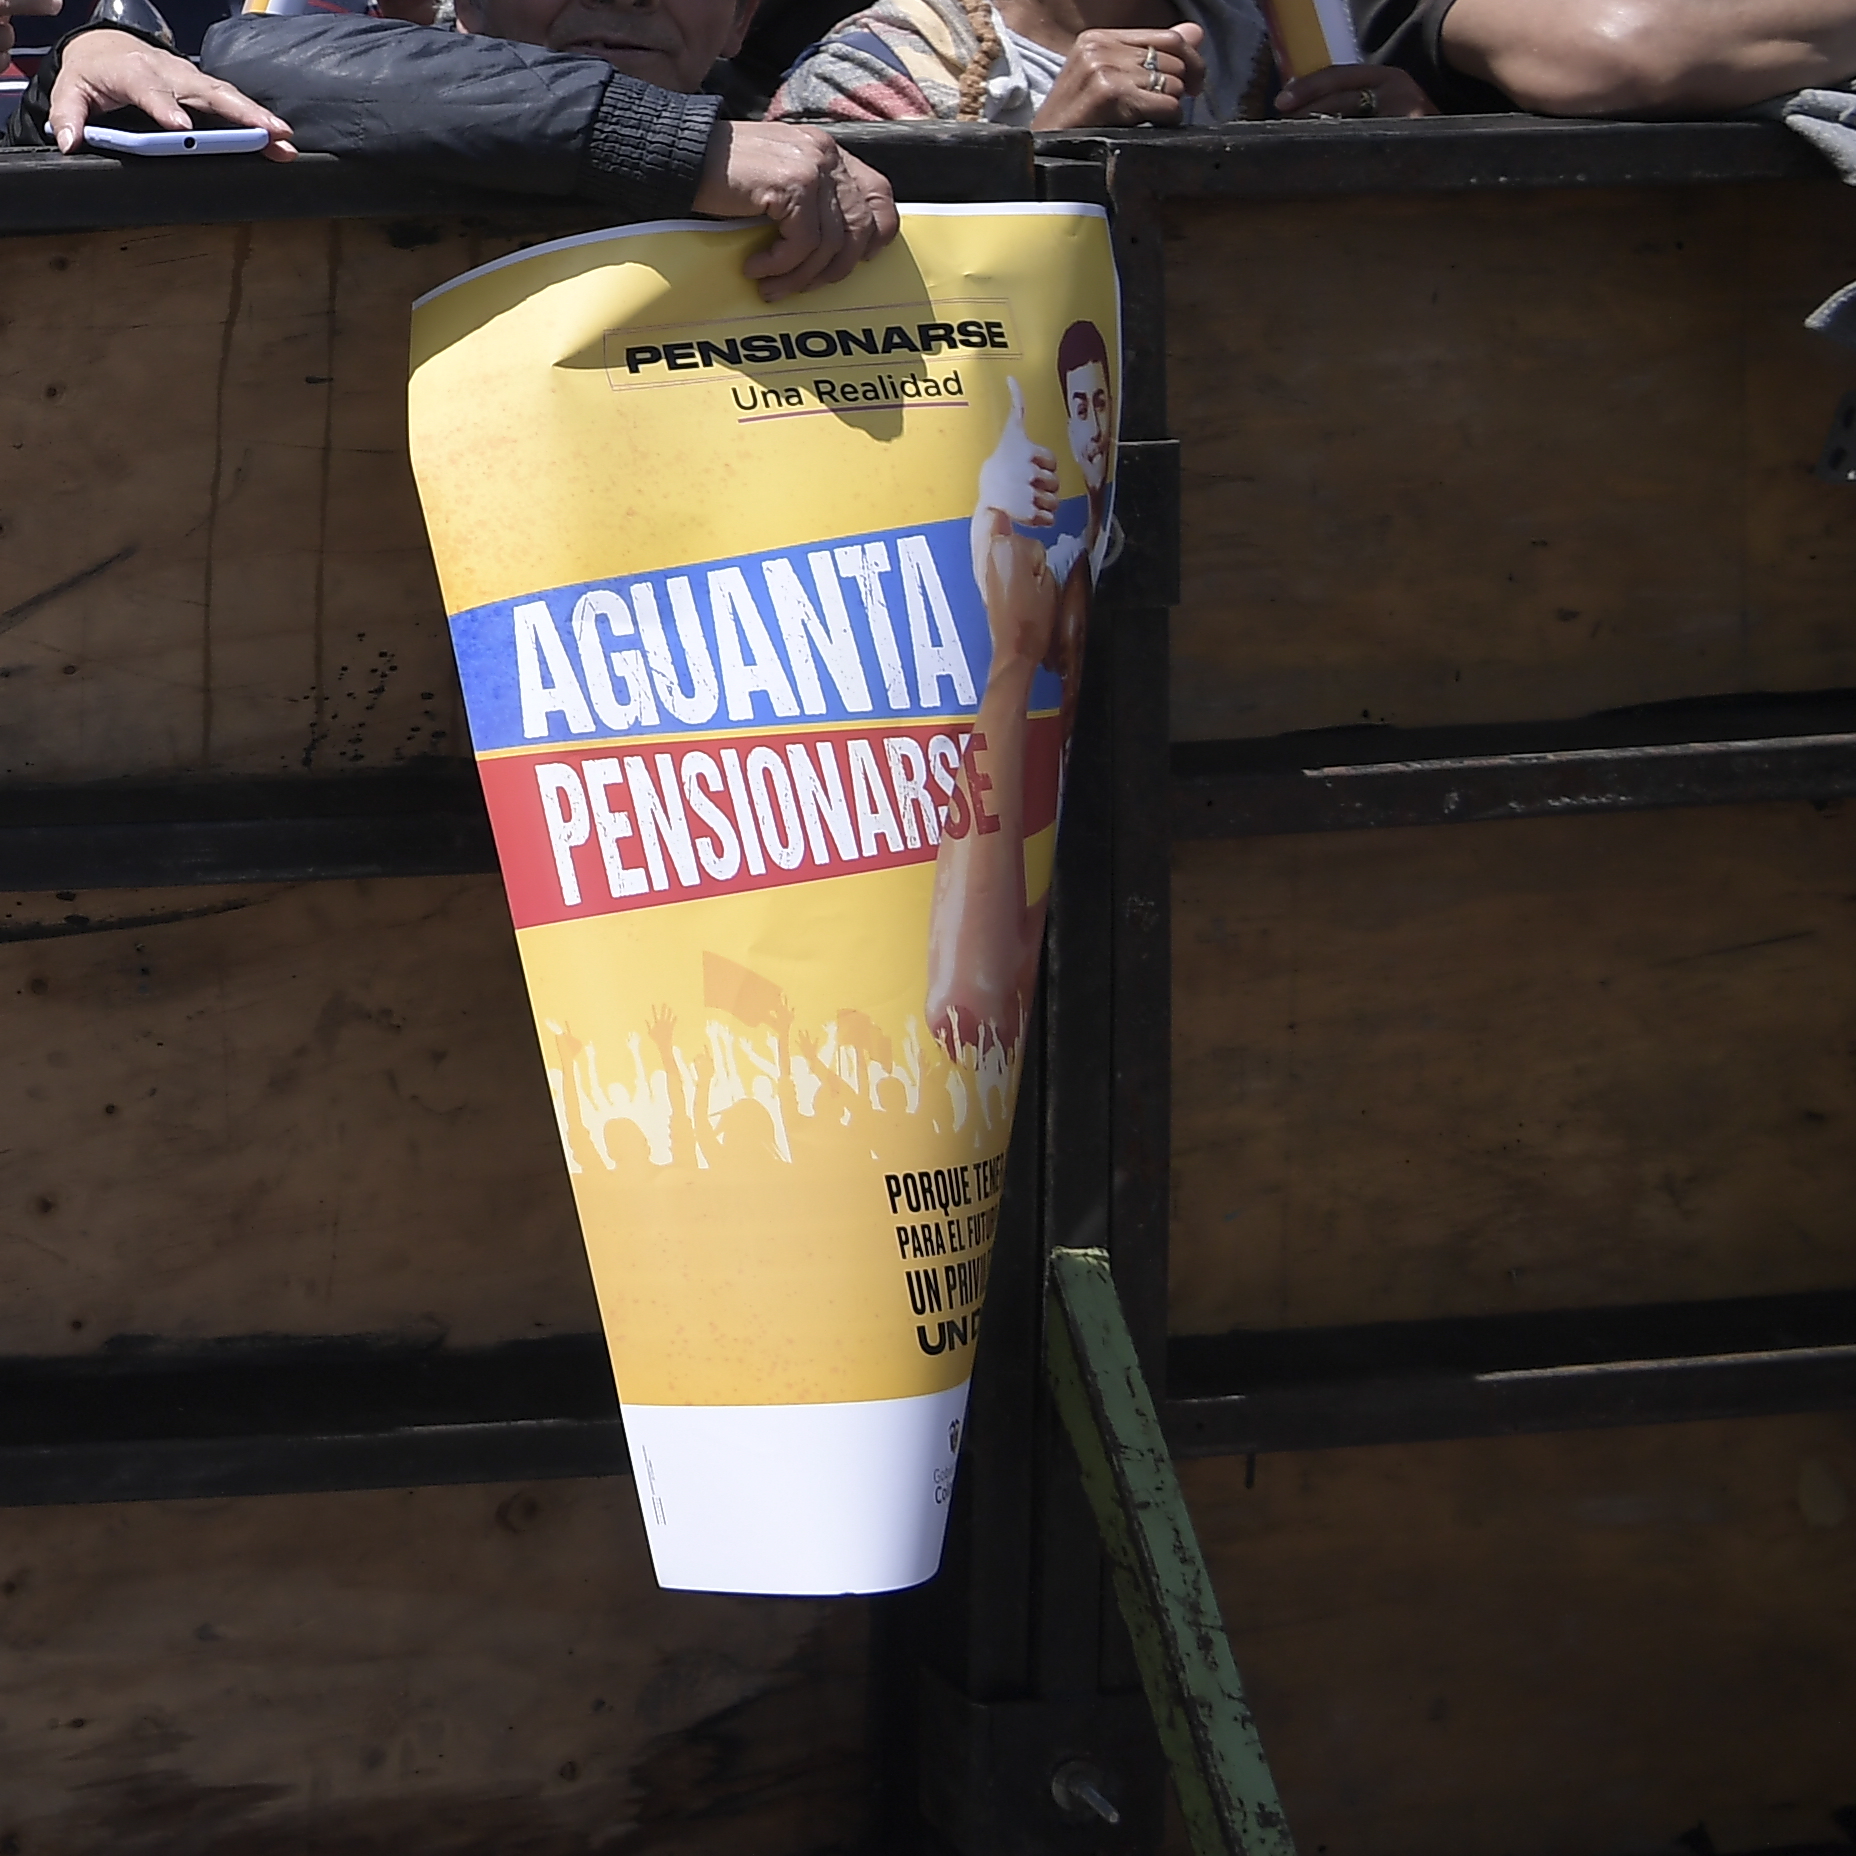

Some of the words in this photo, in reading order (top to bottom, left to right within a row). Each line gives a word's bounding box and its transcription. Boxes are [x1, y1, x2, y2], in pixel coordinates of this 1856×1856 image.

[626, 321, 1009, 374] PENSIONARSE
[731, 385, 806, 411] Una
[815, 370, 965, 405] Realidad
[512, 535, 978, 739] AGUANTA
[535, 732, 1002, 907] PENSIONARSE
[884, 1165, 972, 1216] PORQUE
[896, 1222, 946, 1260] PARA
[947, 1219, 965, 1253] EL
[905, 1267, 942, 1316] UN
[916, 1316, 967, 1356] UN
